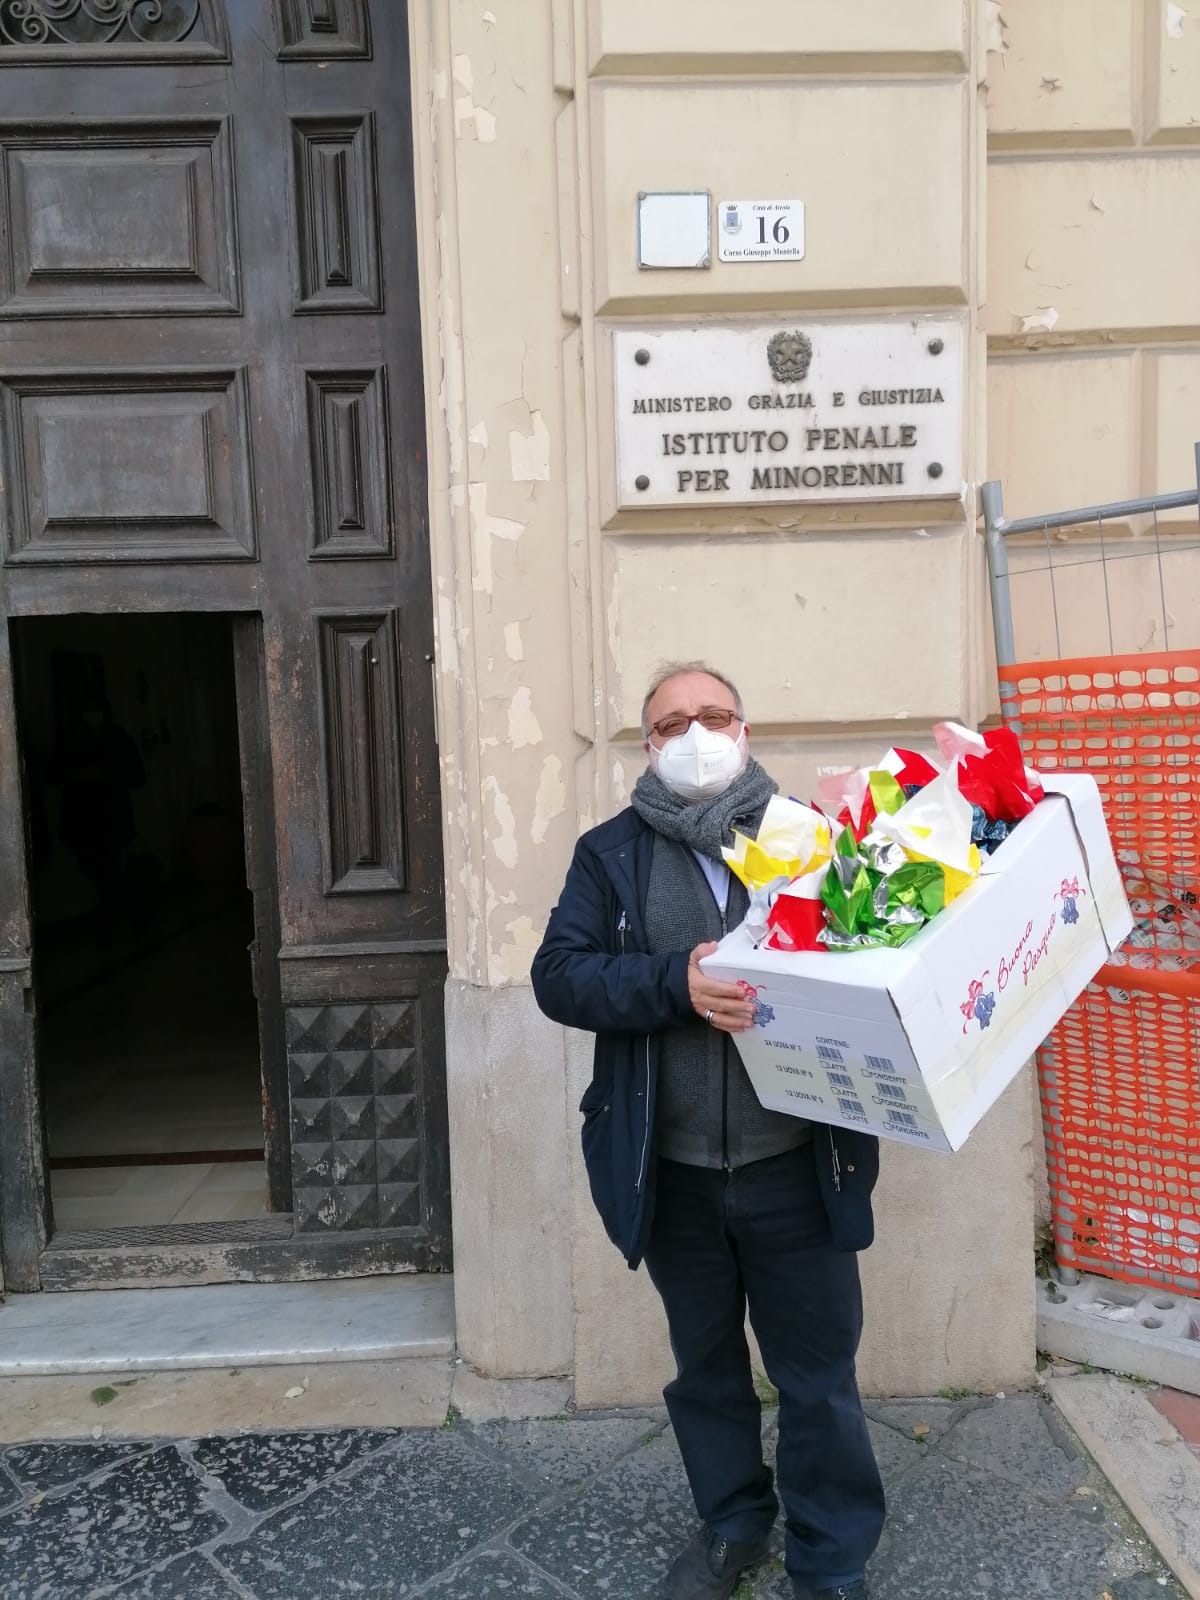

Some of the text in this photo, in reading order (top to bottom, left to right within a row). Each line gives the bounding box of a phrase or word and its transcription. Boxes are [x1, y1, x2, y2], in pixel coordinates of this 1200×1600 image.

[756, 215, 790, 244] 16
[723, 249, 742, 257] Corso
[743, 248, 772, 258] Giuseppe
[632, 388, 945, 414] MINISTERO GRAZIA E GIUSTIZIA
[662, 425, 918, 456] ISTITUTO PENALE
[677, 462, 905, 492] PER MINORENNI
[998, 919, 1034, 992] Buona
[1022, 911, 1057, 986] Pasqua
[773, 1040, 790, 1050] UOVA
[783, 1065, 800, 1075] UOVA
[829, 1062, 848, 1073] LATTE
[870, 1071, 908, 1085] FONDENTE
[793, 1090, 811, 1101] UOVA
[839, 1089, 859, 1099] LATTE
[881, 1098, 919, 1113] FONDENTE
[848, 1114, 869, 1124] LATTE
[891, 1124, 930, 1139] FONDENTE
